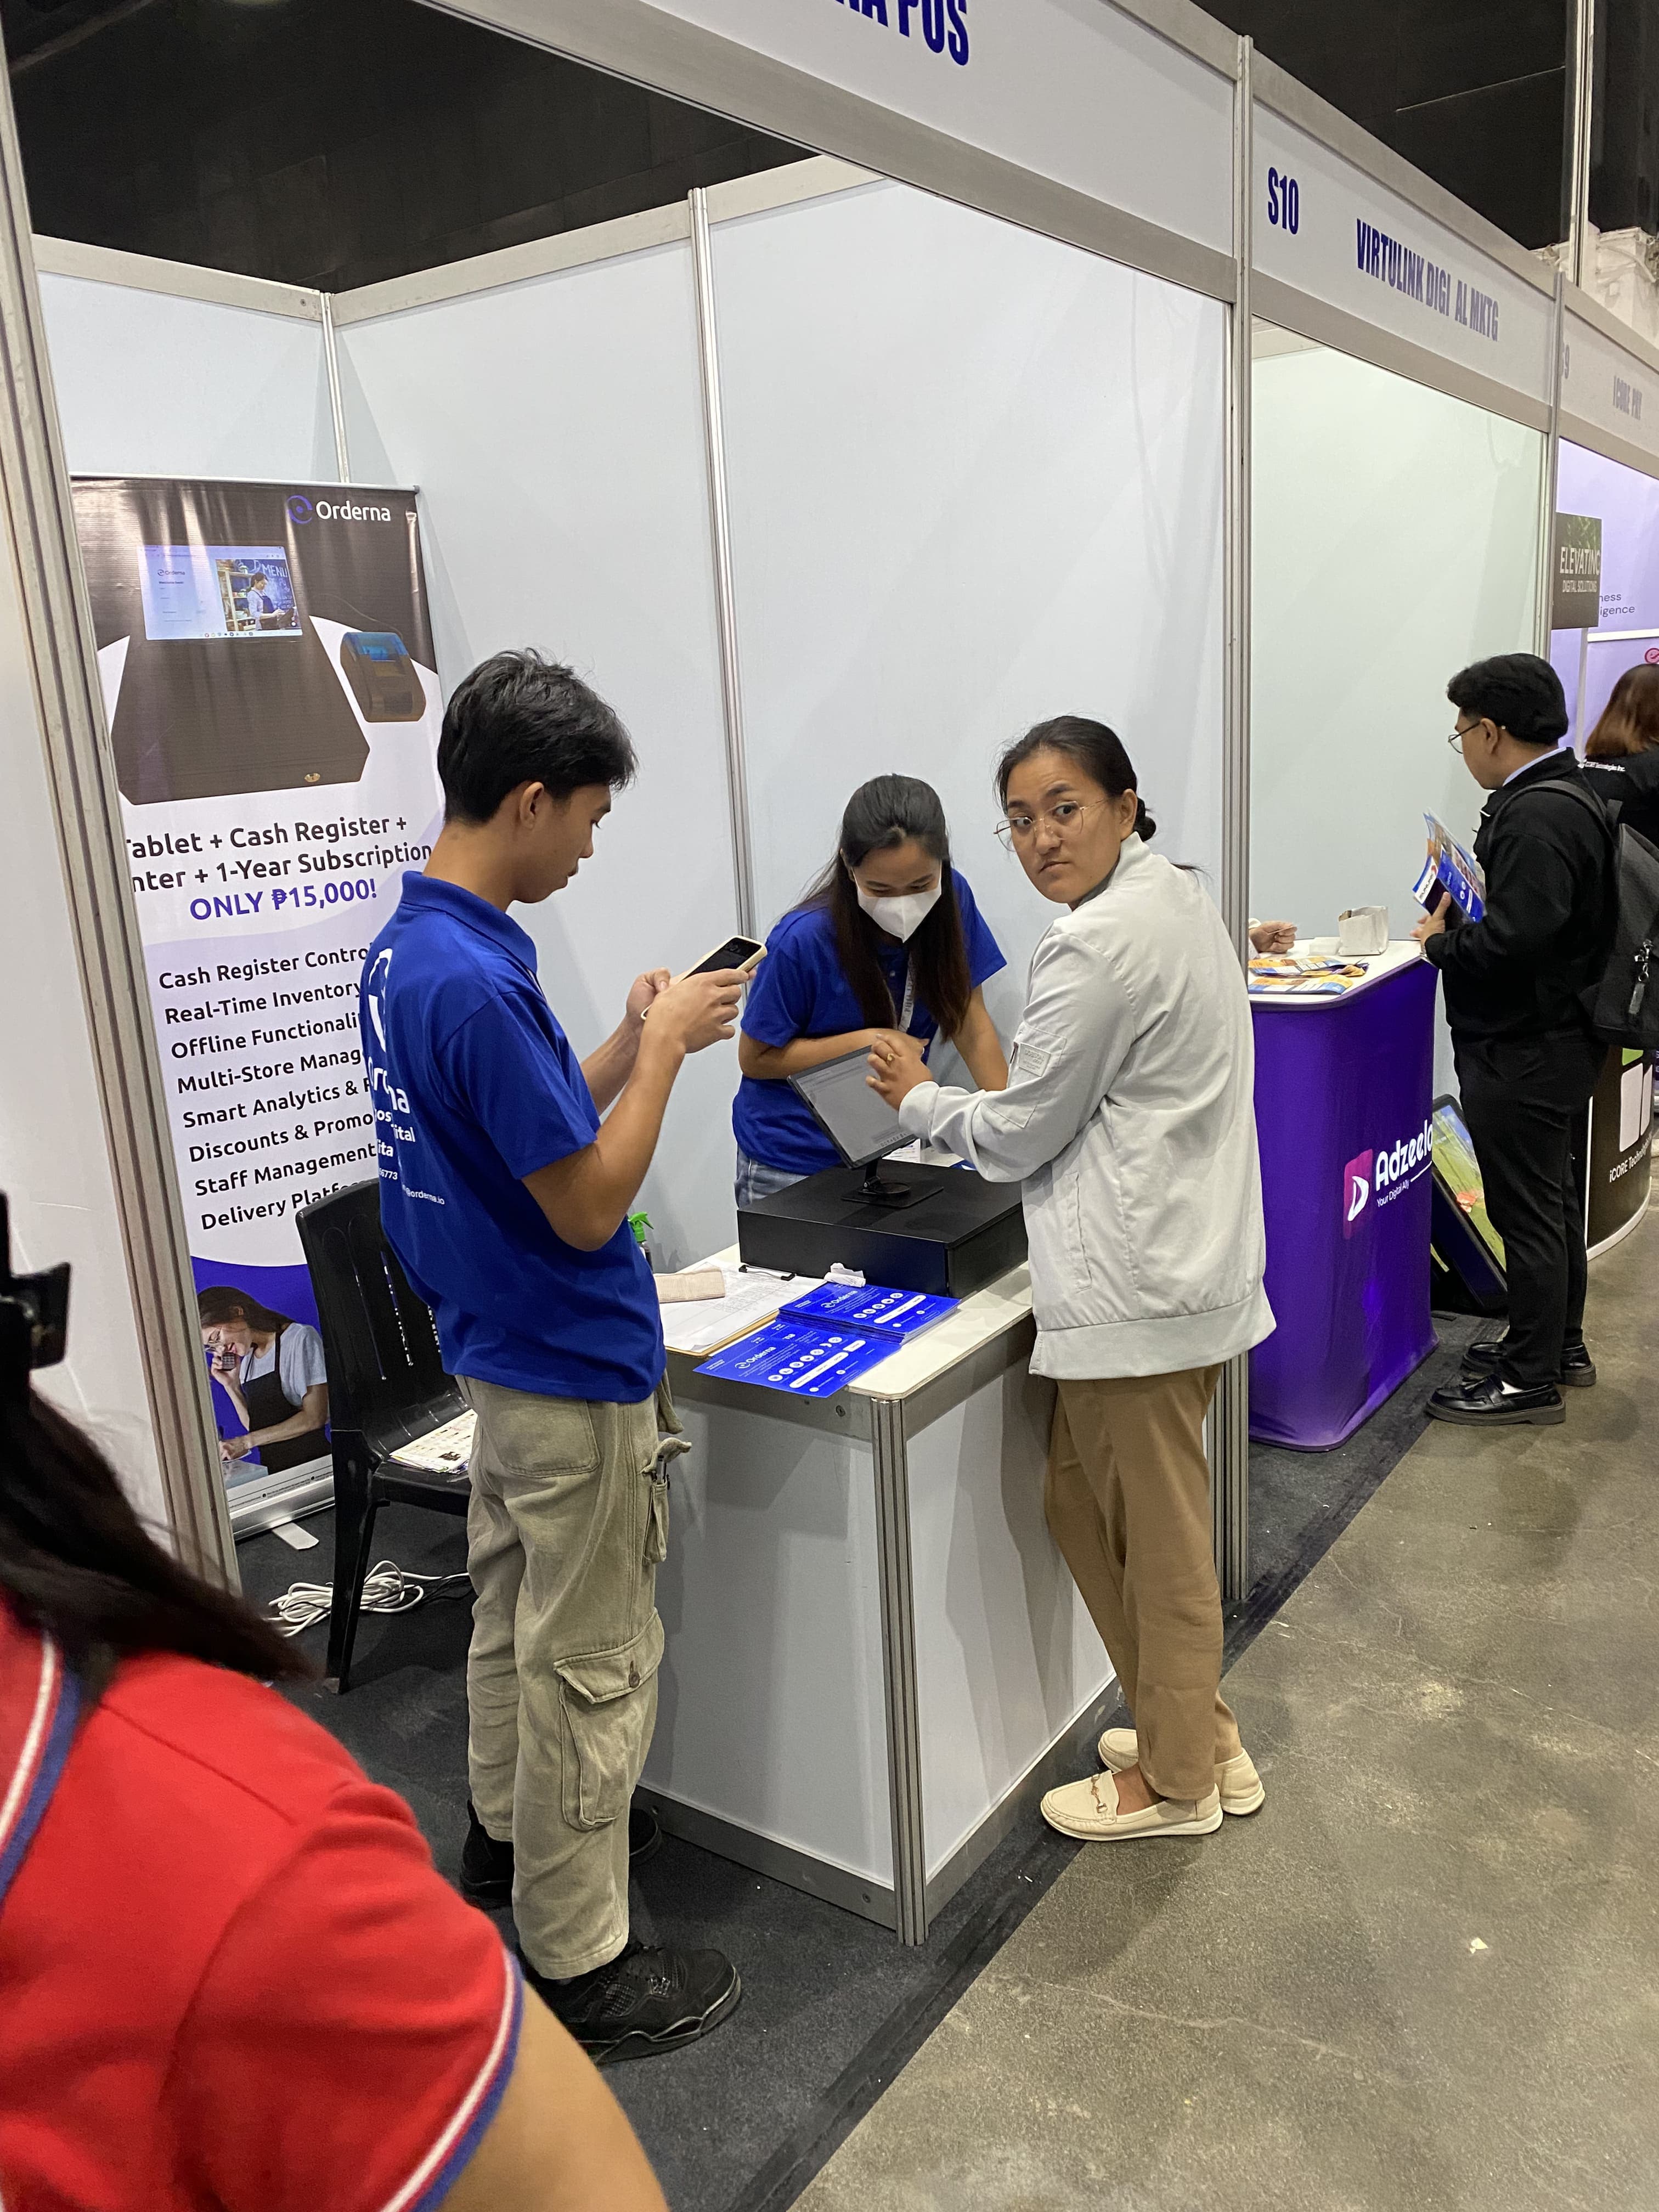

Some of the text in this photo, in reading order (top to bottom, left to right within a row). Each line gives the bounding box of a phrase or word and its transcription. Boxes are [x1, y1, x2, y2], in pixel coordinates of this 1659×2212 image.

[1267, 167, 1299, 235] S10
[1357, 218, 1424, 302] VIRTULINK
[1470, 287, 1499, 342] MKTG
[316, 500, 391, 522] Orderna
[1600, 606, 1635, 617] igence
[126, 833, 202, 859] ablet
[230, 822, 289, 848] Cash
[295, 816, 390, 843] Register
[132, 871, 186, 893] nter
[216, 859, 291, 883] 1-Year
[298, 842, 432, 873] Subscription
[189, 878, 377, 920] ONLY ₱15,000!
[159, 942, 374, 990] Cash Register Contro
[165, 982, 360, 1025] Real-Time Inventory
[171, 1012, 360, 1059] Offline Functionali
[177, 1048, 364, 1094] Multi-Store Manag
[183, 1103, 247, 1128] Smart
[252, 1085, 340, 1116] Analytics
[345, 1080, 359, 1096] &
[189, 1131, 289, 1163] Discounts
[295, 1124, 309, 1140] &
[195, 1142, 377, 1196] Staff Management
[1609, 1159, 1628, 1183] iCORE
[201, 1199, 286, 1231] Delivery
[1376, 1195, 1389, 1207] Your
[1389, 1183, 1403, 1200] Digital
[746, 1346, 777, 1363] Orderna
